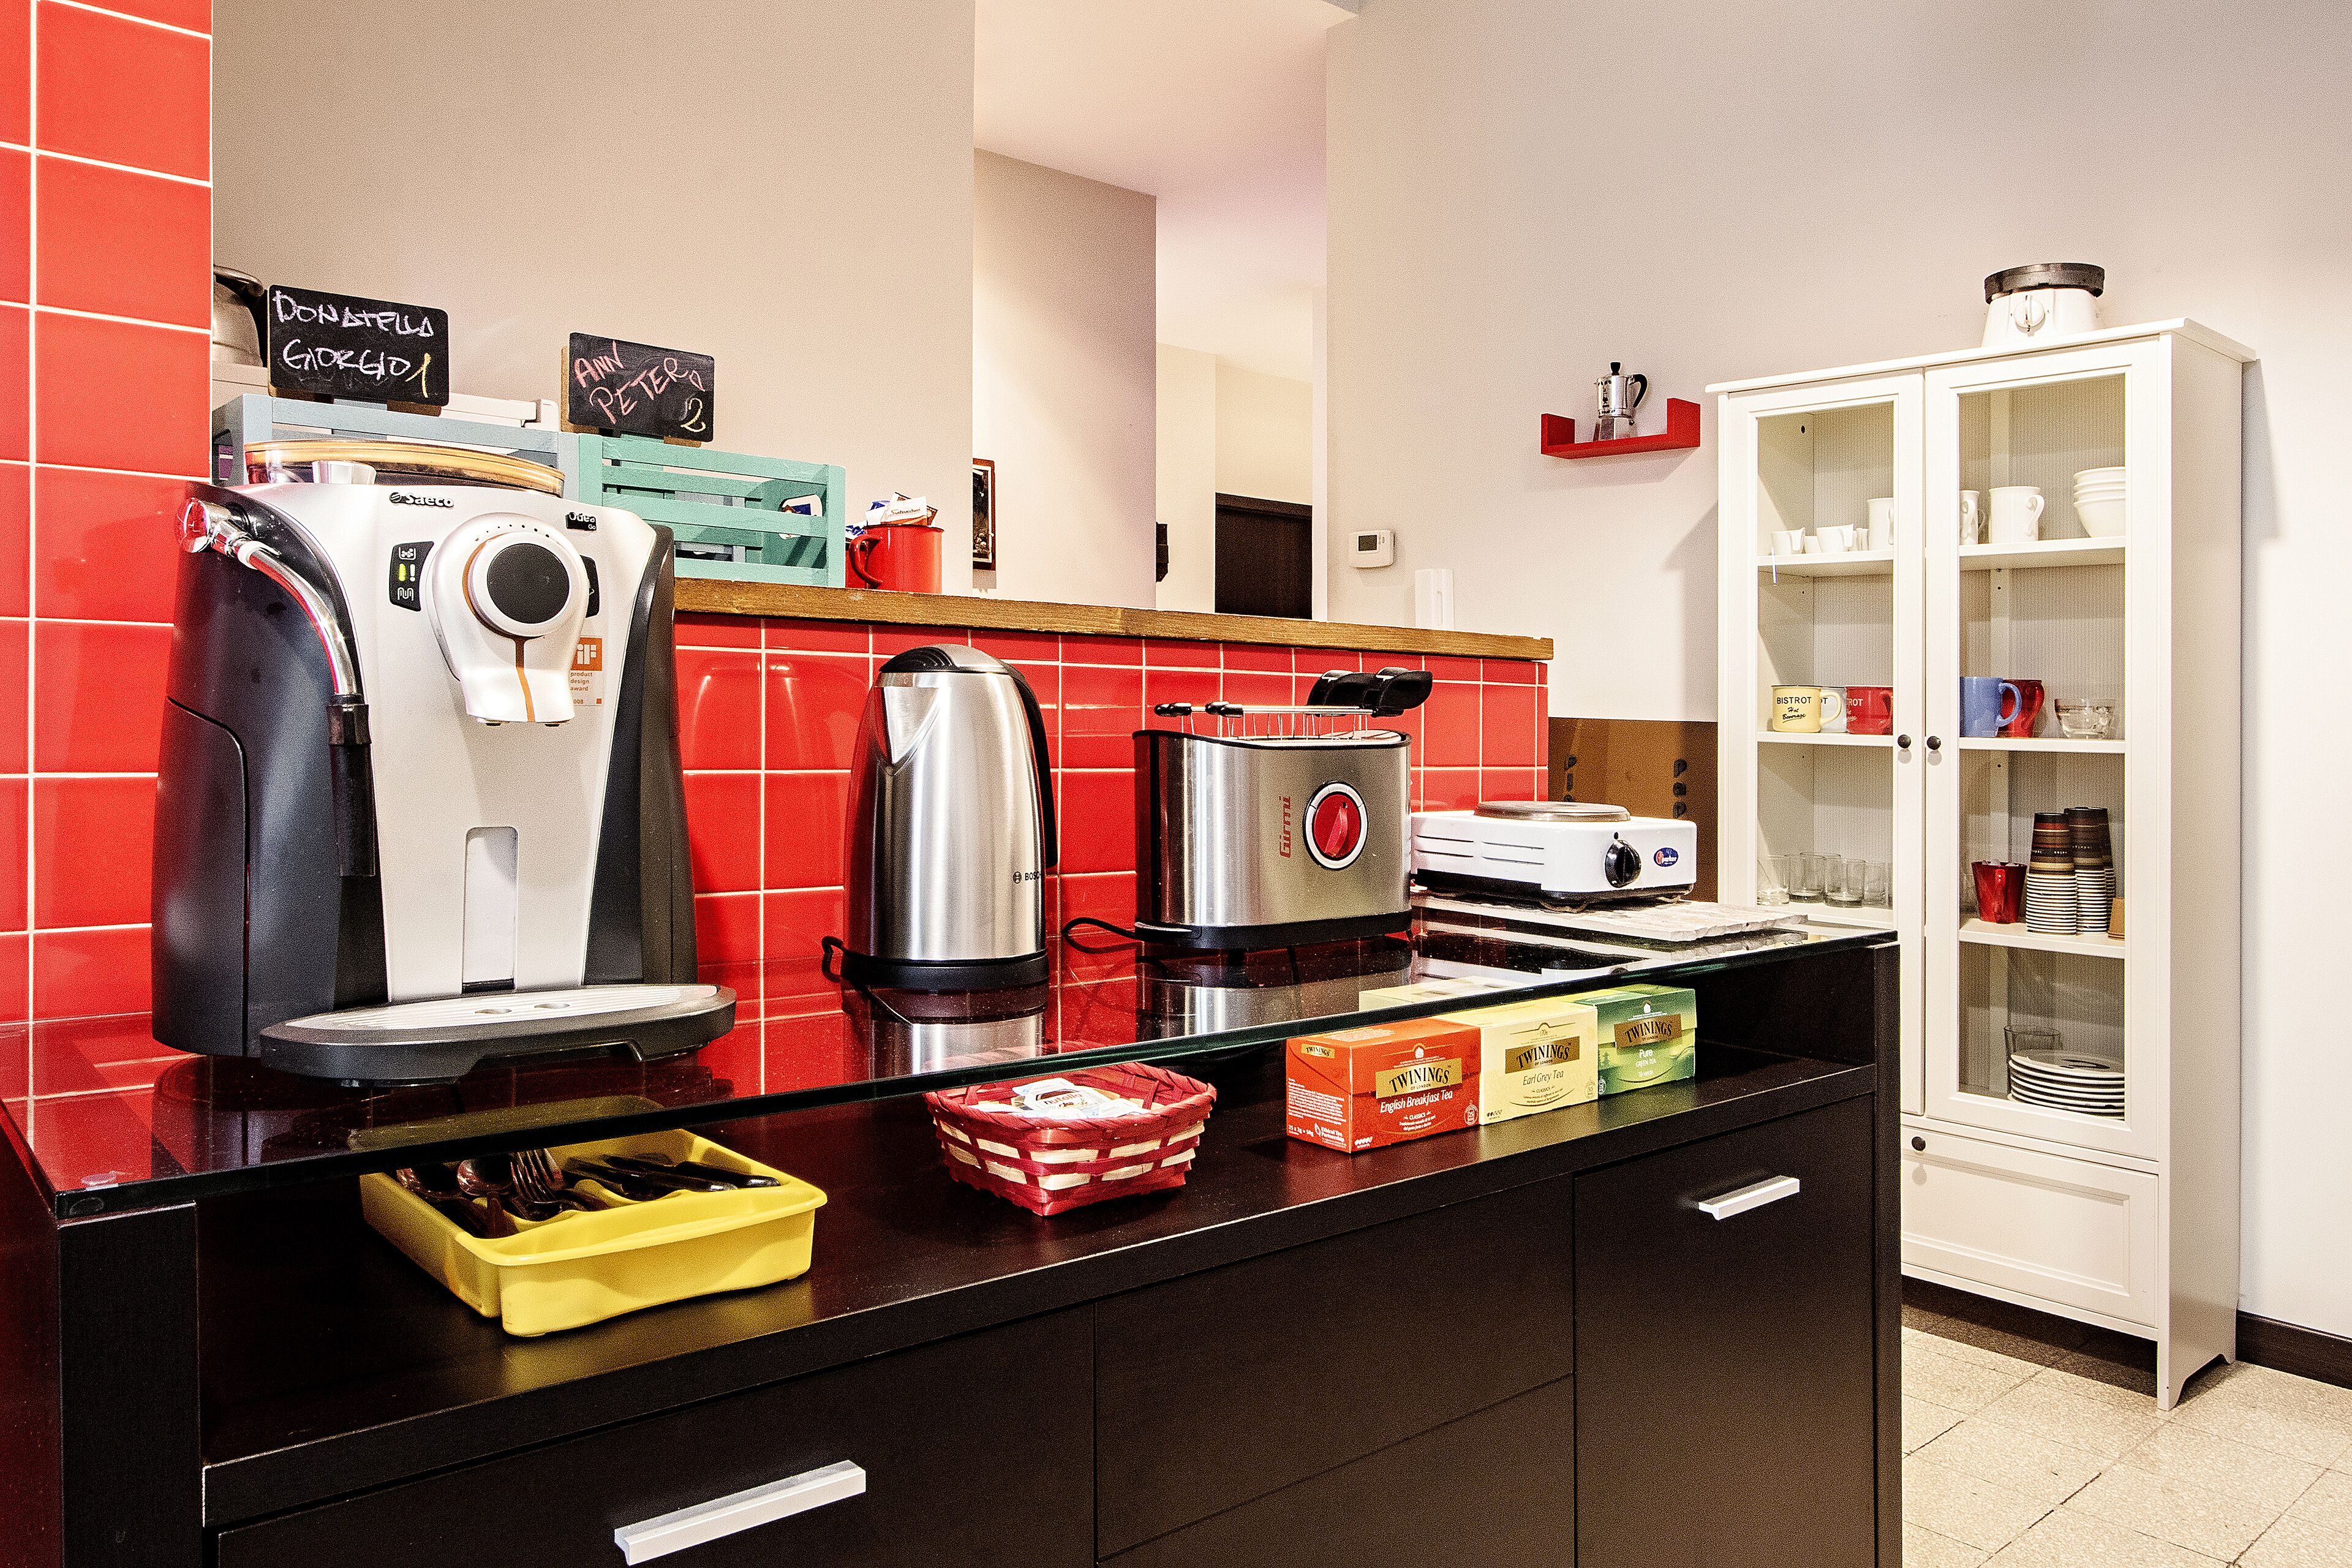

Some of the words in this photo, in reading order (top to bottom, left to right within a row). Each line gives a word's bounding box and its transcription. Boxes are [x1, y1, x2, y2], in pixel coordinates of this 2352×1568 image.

[273, 290, 434, 337] DONATELLA
[282, 339, 411, 381] GIORGIO
[574, 340, 624, 388] ANN
[404, 353, 431, 398] 1
[589, 357, 688, 425] PETER
[680, 398, 706, 432] 2
[405, 492, 454, 508] Saeco
[1025, 871, 1041, 881] BOSC
[1625, 1021, 1672, 1042] TWININGS
[1306, 1046, 1330, 1057] TWININGS
[1517, 1044, 1569, 1069] TWININGS
[1639, 1049, 1653, 1058] Pure
[1389, 1067, 1450, 1093] TWININGS
[1523, 1074, 1536, 1085] Earl
[1537, 1072, 1551, 1083] Grey
[1553, 1069, 1564, 1079] Tea
[1044, 1093, 1082, 1104] nutella
[1380, 1098, 1406, 1114] English
[1406, 1093, 1440, 1107] Breakfast
[1441, 1090, 1453, 1100] Tea
